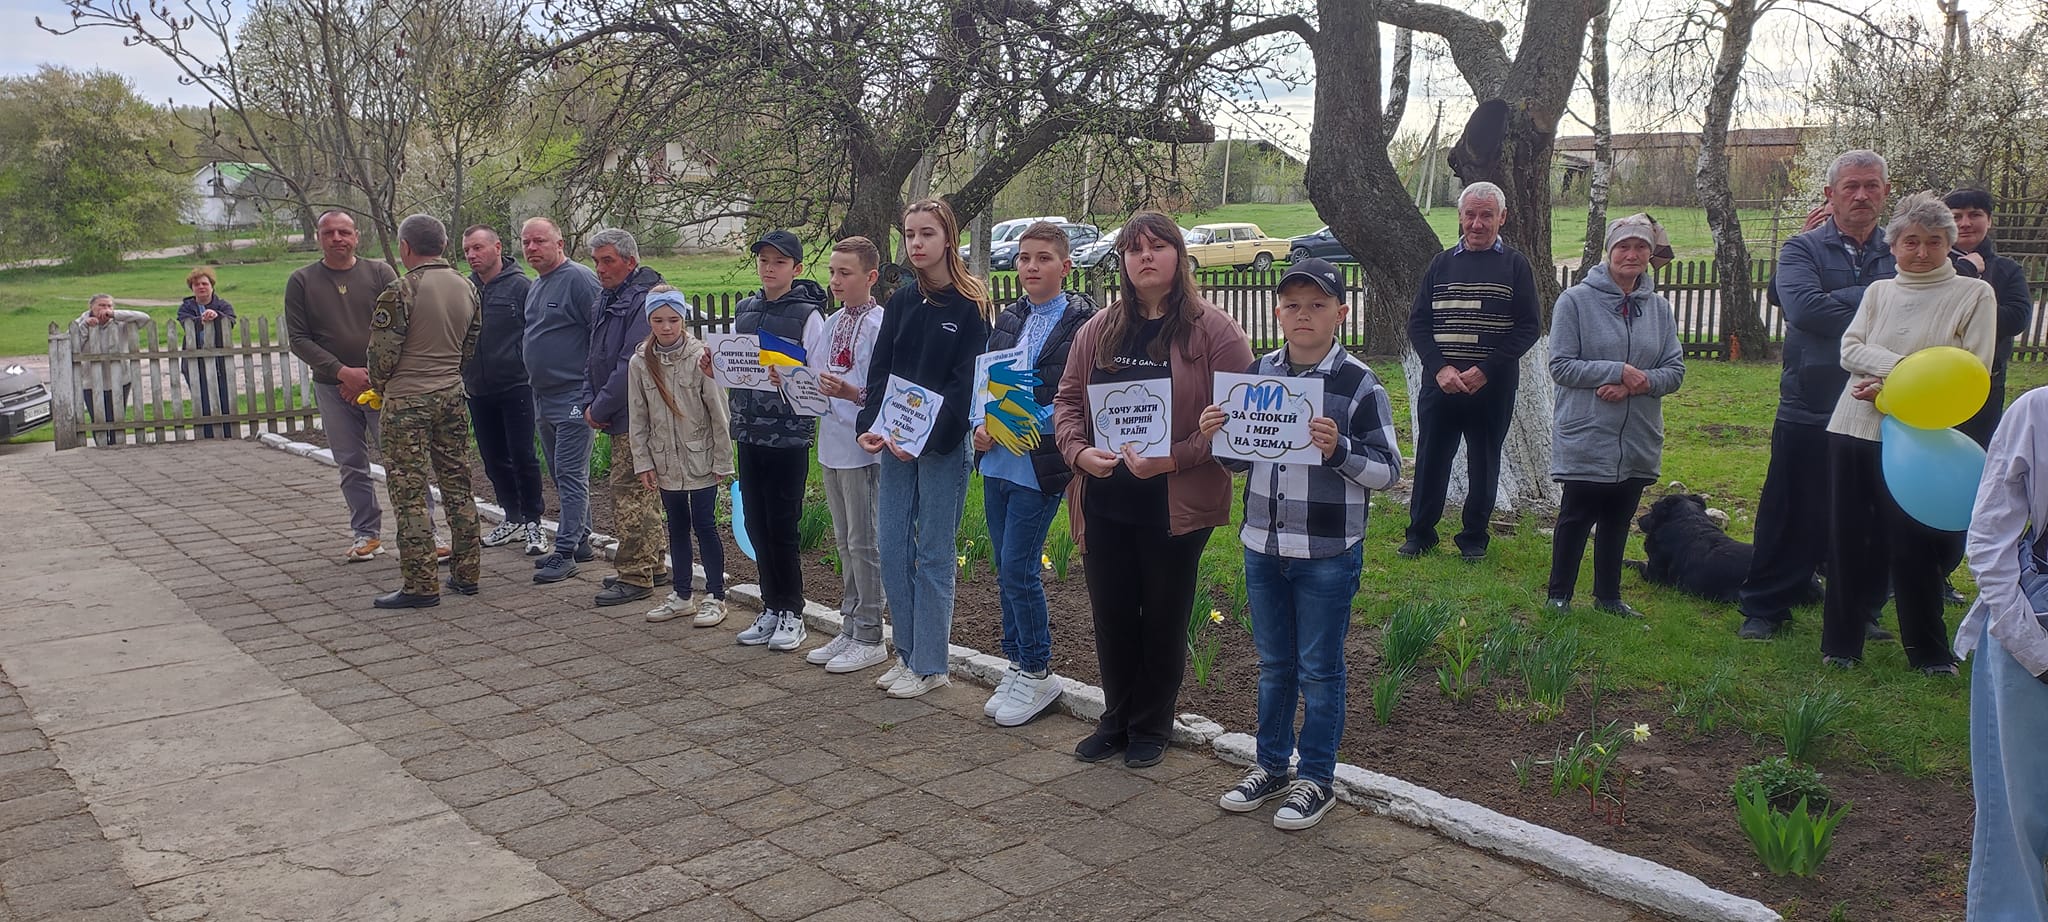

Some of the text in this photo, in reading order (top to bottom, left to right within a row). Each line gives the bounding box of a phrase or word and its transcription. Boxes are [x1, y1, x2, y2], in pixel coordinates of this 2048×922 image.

[1139, 359, 1168, 368] GANR
[1244, 384, 1284, 411] МИ
[891, 401, 927, 421] МИРНОГО НЕБА
[1108, 404, 1158, 415] ХОЧУ ЖИТИ
[1122, 414, 1153, 425] МИРНІЙ
[1231, 410, 1298, 424] ЗА СПОКІЙ
[1120, 425, 1147, 435] КРАЇНІ
[1245, 425, 1279, 436] І МИР
[1234, 436, 1293, 450] НА ЗЕМЛІ
